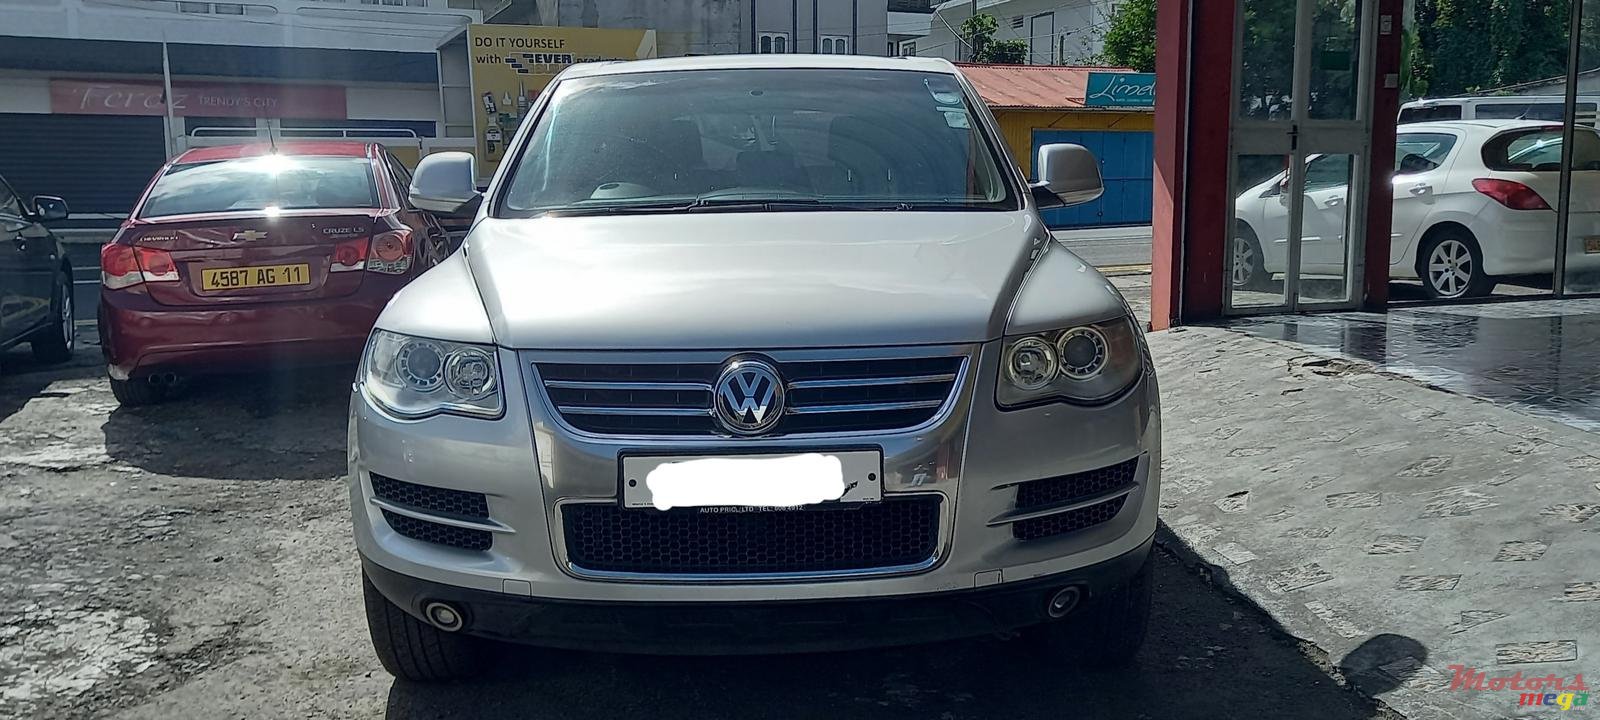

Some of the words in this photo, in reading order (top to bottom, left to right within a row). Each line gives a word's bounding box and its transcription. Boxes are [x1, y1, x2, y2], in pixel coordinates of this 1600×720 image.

[475, 37, 493, 48] DO
[496, 38, 507, 48] IT
[509, 38, 565, 49] YOURSELF
[476, 54, 501, 64] with
[1088, 74, 1156, 102] Limel
[253, 96, 279, 108] CITY
[211, 270, 249, 287] 4587
[257, 268, 276, 285] AG
[283, 266, 301, 283] 11
[699, 506, 719, 514] AUTO
